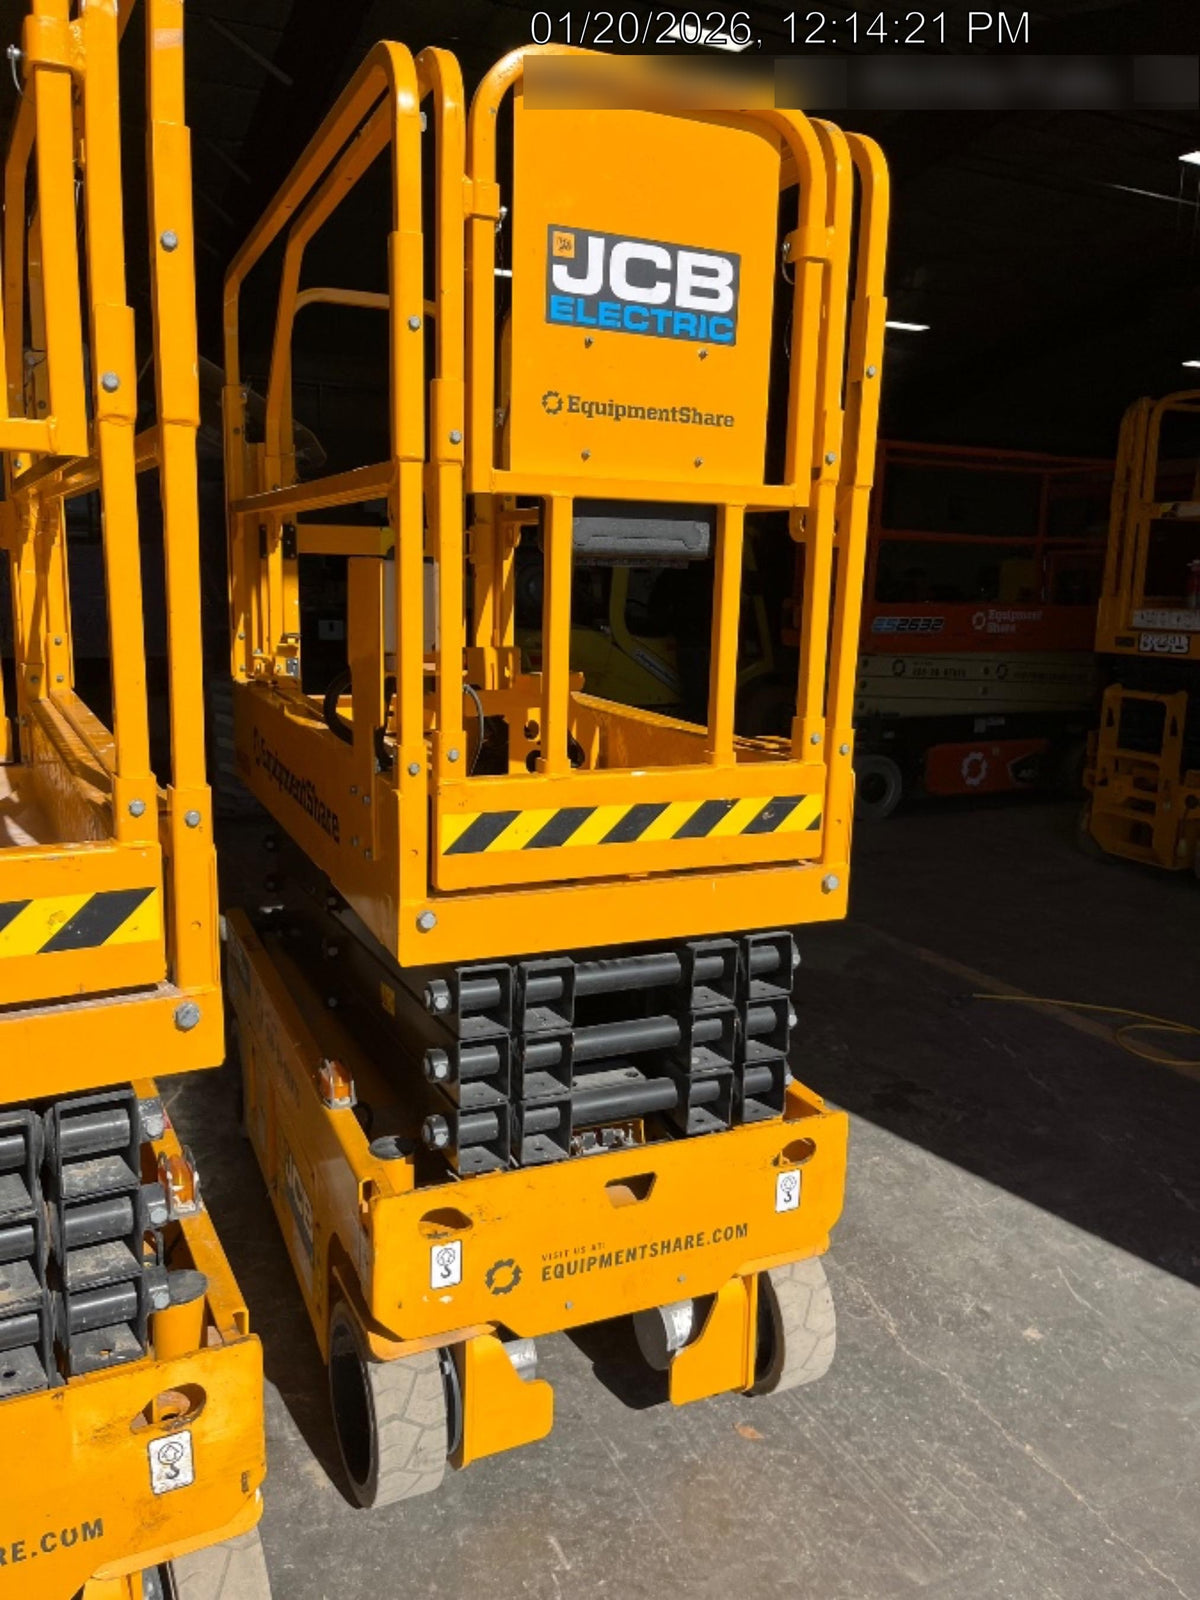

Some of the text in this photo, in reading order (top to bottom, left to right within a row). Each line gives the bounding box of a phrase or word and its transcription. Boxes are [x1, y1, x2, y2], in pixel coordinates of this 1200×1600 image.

[553, 236, 734, 313] JCB
[551, 295, 734, 342] ELECTRIC
[567, 395, 735, 427] EquipmentShare
[872, 616, 944, 633] ES2632
[542, 1223, 749, 1282] EQUIPMENTSHARE.COM
[542, 1250, 569, 1262] VISIT
[574, 1245, 586, 1255] US
